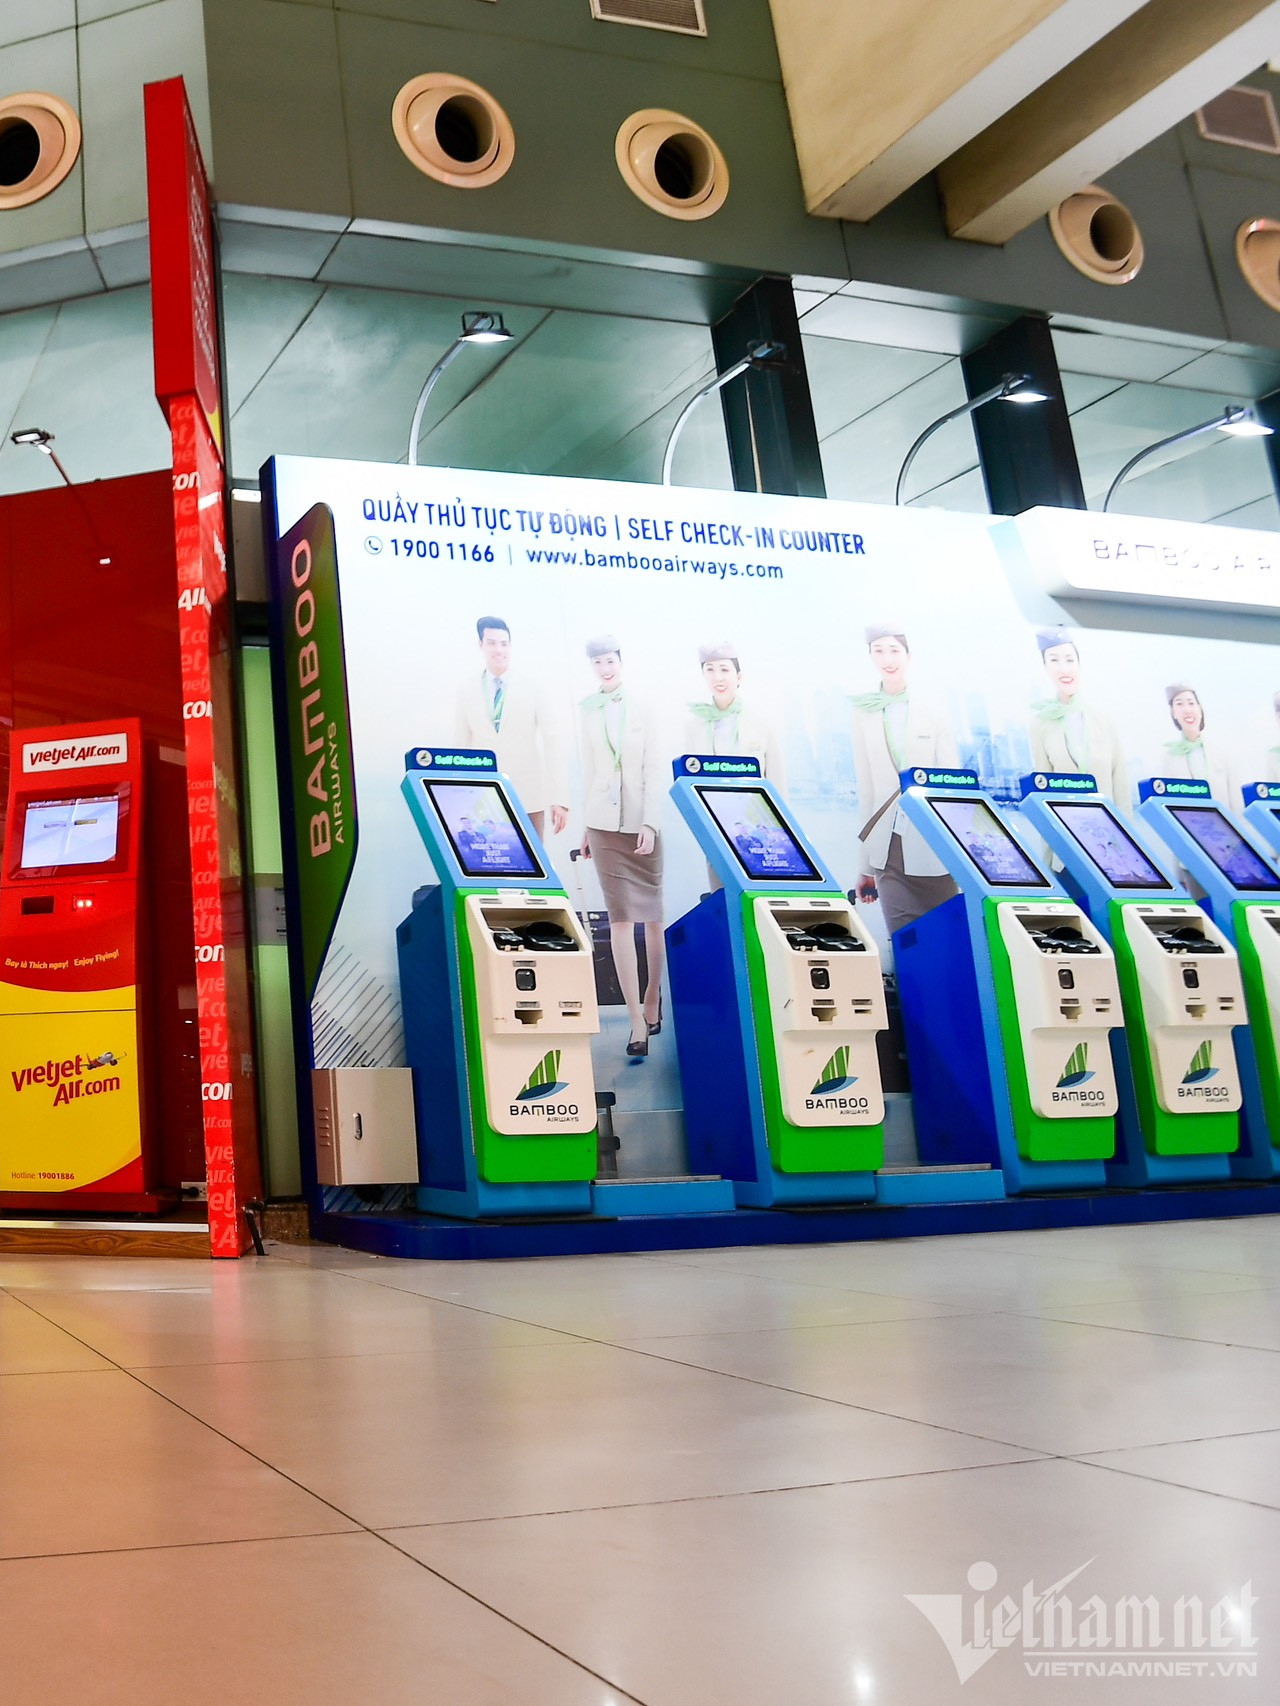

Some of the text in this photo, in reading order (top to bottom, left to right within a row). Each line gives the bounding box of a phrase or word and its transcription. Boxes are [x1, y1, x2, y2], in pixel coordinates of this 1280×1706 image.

[425, 497, 465, 528] THỦ
[471, 506, 512, 536] TỤC
[516, 508, 545, 539] TỰ
[549, 509, 607, 542] ĐỘNG
[628, 518, 674, 541] SELF
[680, 521, 775, 550] CHECK-IN
[780, 529, 865, 554] COUNTER
[391, 538, 440, 560] 1900
[447, 543, 495, 563] 1166
[526, 548, 783, 579] www.bambooairways.com
[291, 538, 332, 858] BAMBOO
[327, 720, 346, 844] AIRWAYS
[5, 958, 19, 968] Bay
[29, 961, 47, 969] Thích
[49, 960, 68, 970] ngay!
[74, 958, 94, 966] Enjoy
[95, 949, 119, 962] Flying!
[1052, 1092, 1104, 1101] BAMBOO
[1178, 1087, 1228, 1097] BAMBOO
[510, 1105, 578, 1116] BAMBOO
[806, 1098, 868, 1110] BAMBOO
